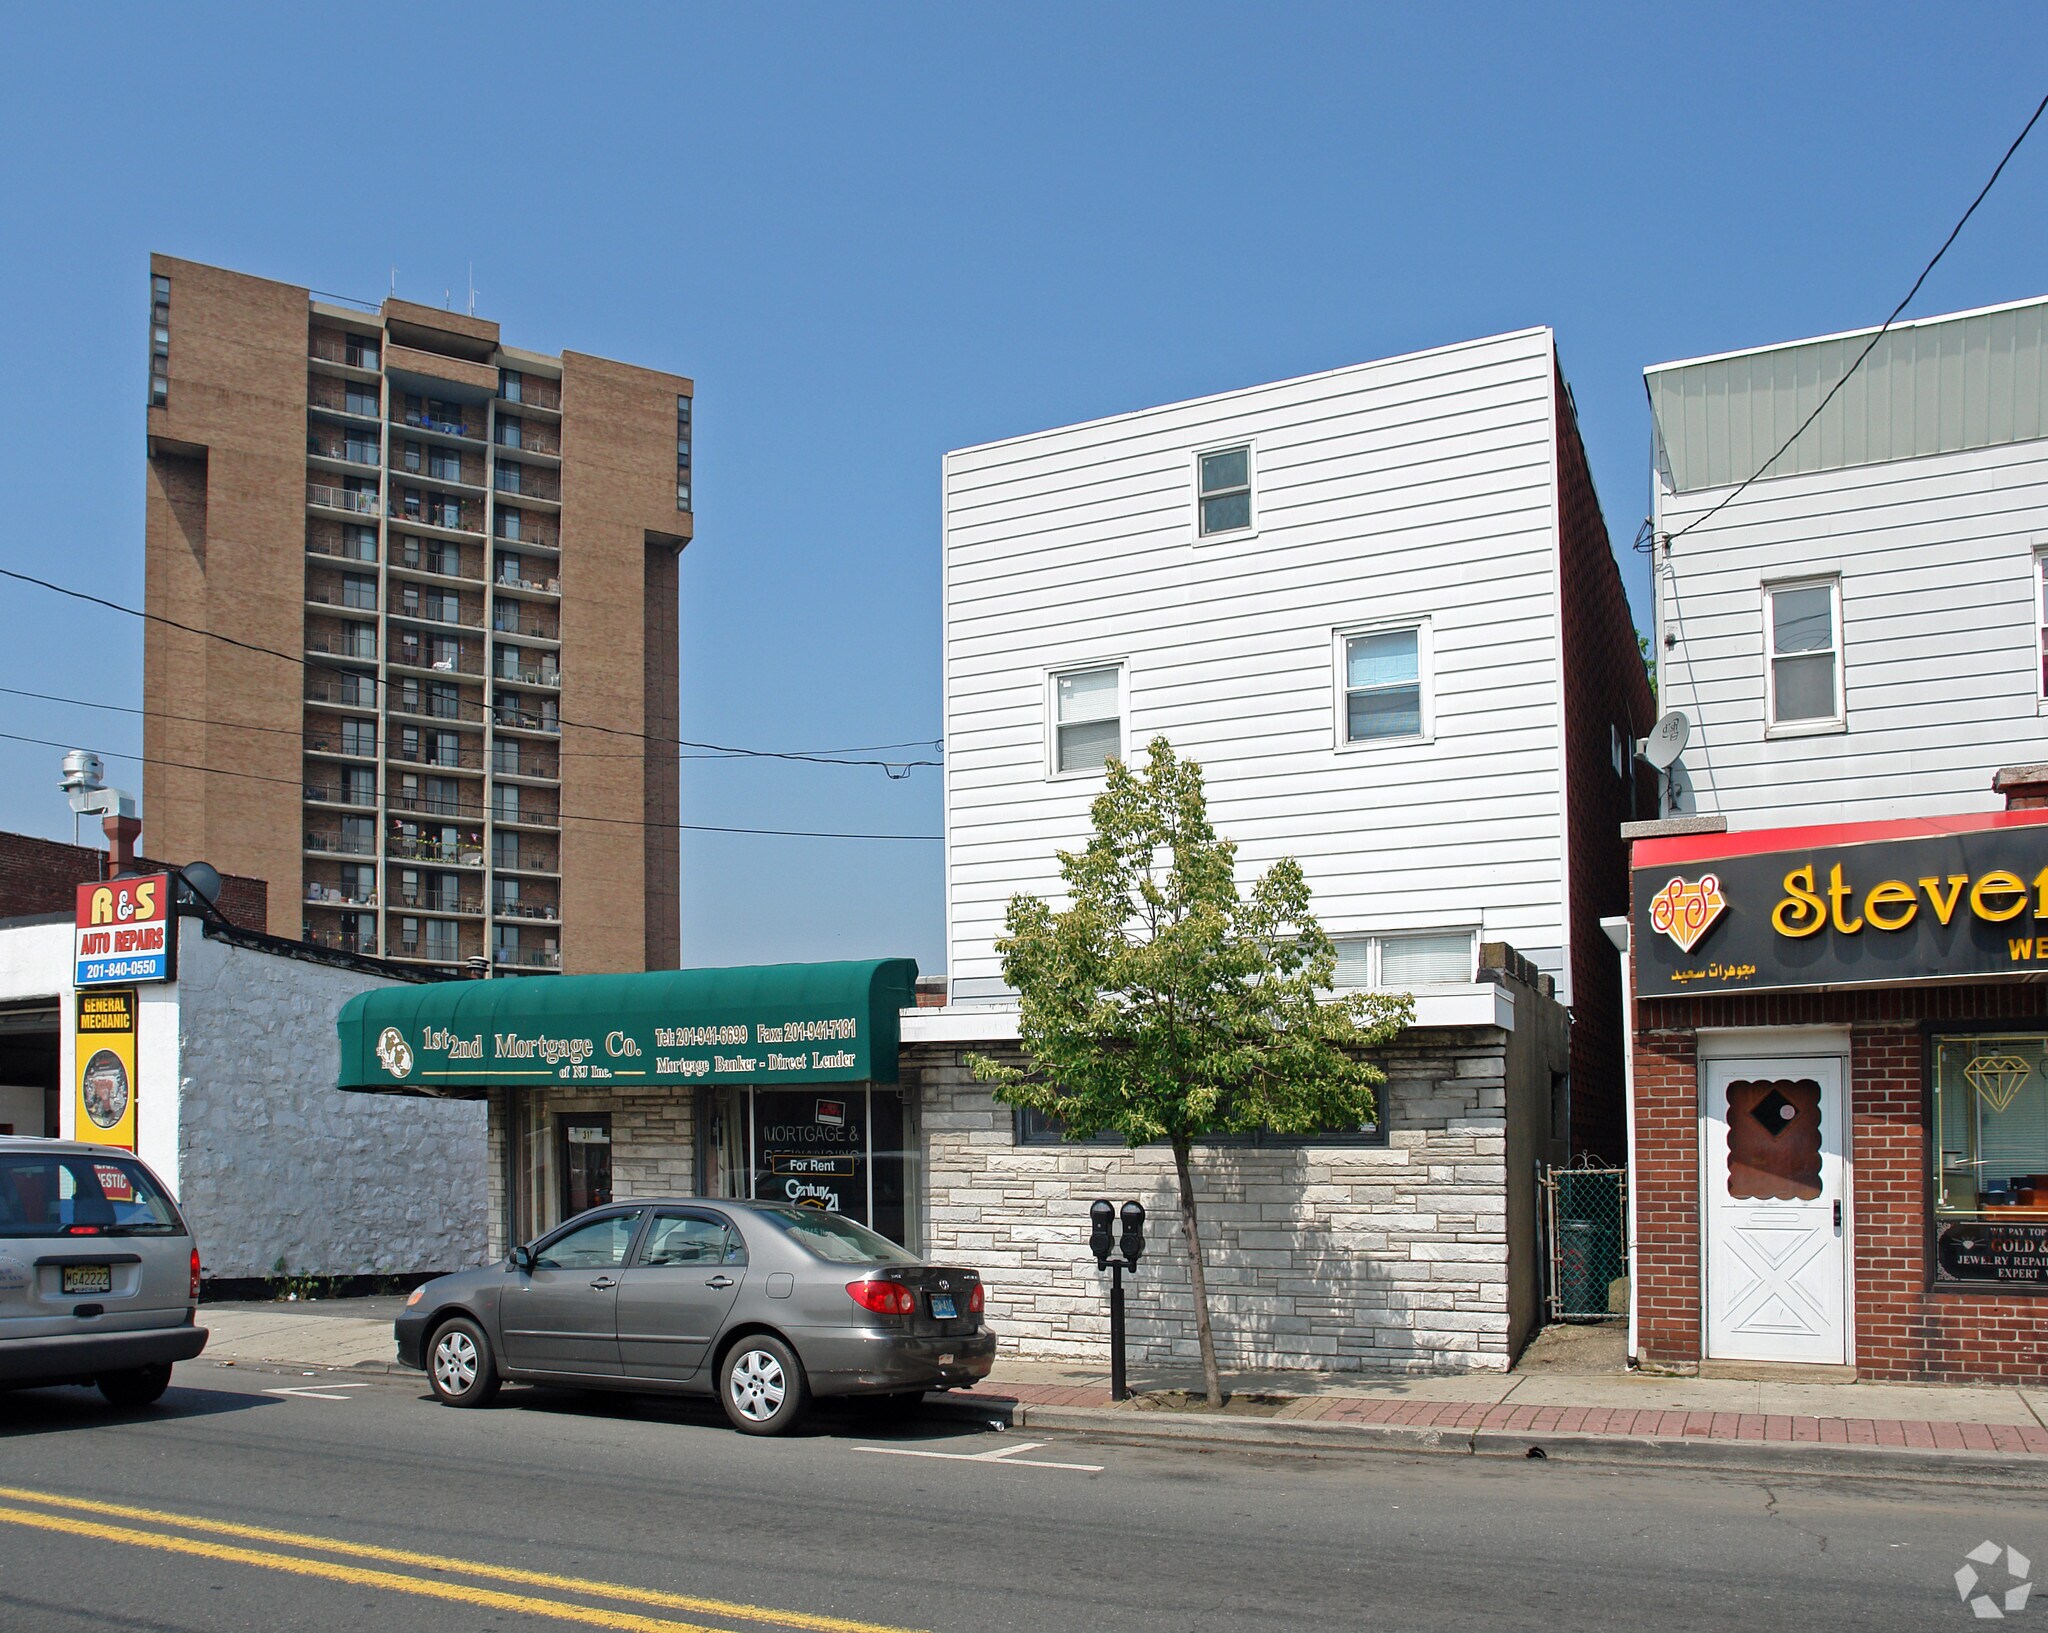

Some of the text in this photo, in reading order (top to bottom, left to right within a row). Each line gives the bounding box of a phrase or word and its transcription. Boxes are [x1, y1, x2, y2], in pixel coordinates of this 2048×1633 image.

[91, 882, 155, 925] R & S
[80, 927, 163, 955] AUTO REPAIRS
[87, 959, 156, 978] 201-840-0550
[1671, 963, 1757, 984] مجوهرات سعيد
[84, 997, 126, 1013] GENERAL
[81, 1013, 130, 1028] MECHANIC
[655, 1018, 856, 1047] Tel: 201-941-6699 Fax: 201-941-7181
[494, 1034, 593, 1064] Mortgage
[605, 1031, 642, 1057] Co.
[559, 1066, 612, 1078] of NJ Inc.
[656, 1057, 709, 1077] Mortgage
[714, 1055, 756, 1072] Banker
[768, 1053, 806, 1071] Direct
[812, 1051, 855, 1069] Lender
[764, 1125, 859, 1142] MORTGAGE &
[790, 1160, 835, 1171] For Rent
[785, 1179, 839, 1211] Century 21
[2009, 1228, 2025, 1236] PAY
[2029, 1228, 2047, 1237] TOP
[1991, 1239, 2035, 1253] GOLD
[1957, 1256, 2009, 1265] JEWELRY
[1998, 1268, 2040, 1279] EXPERT
